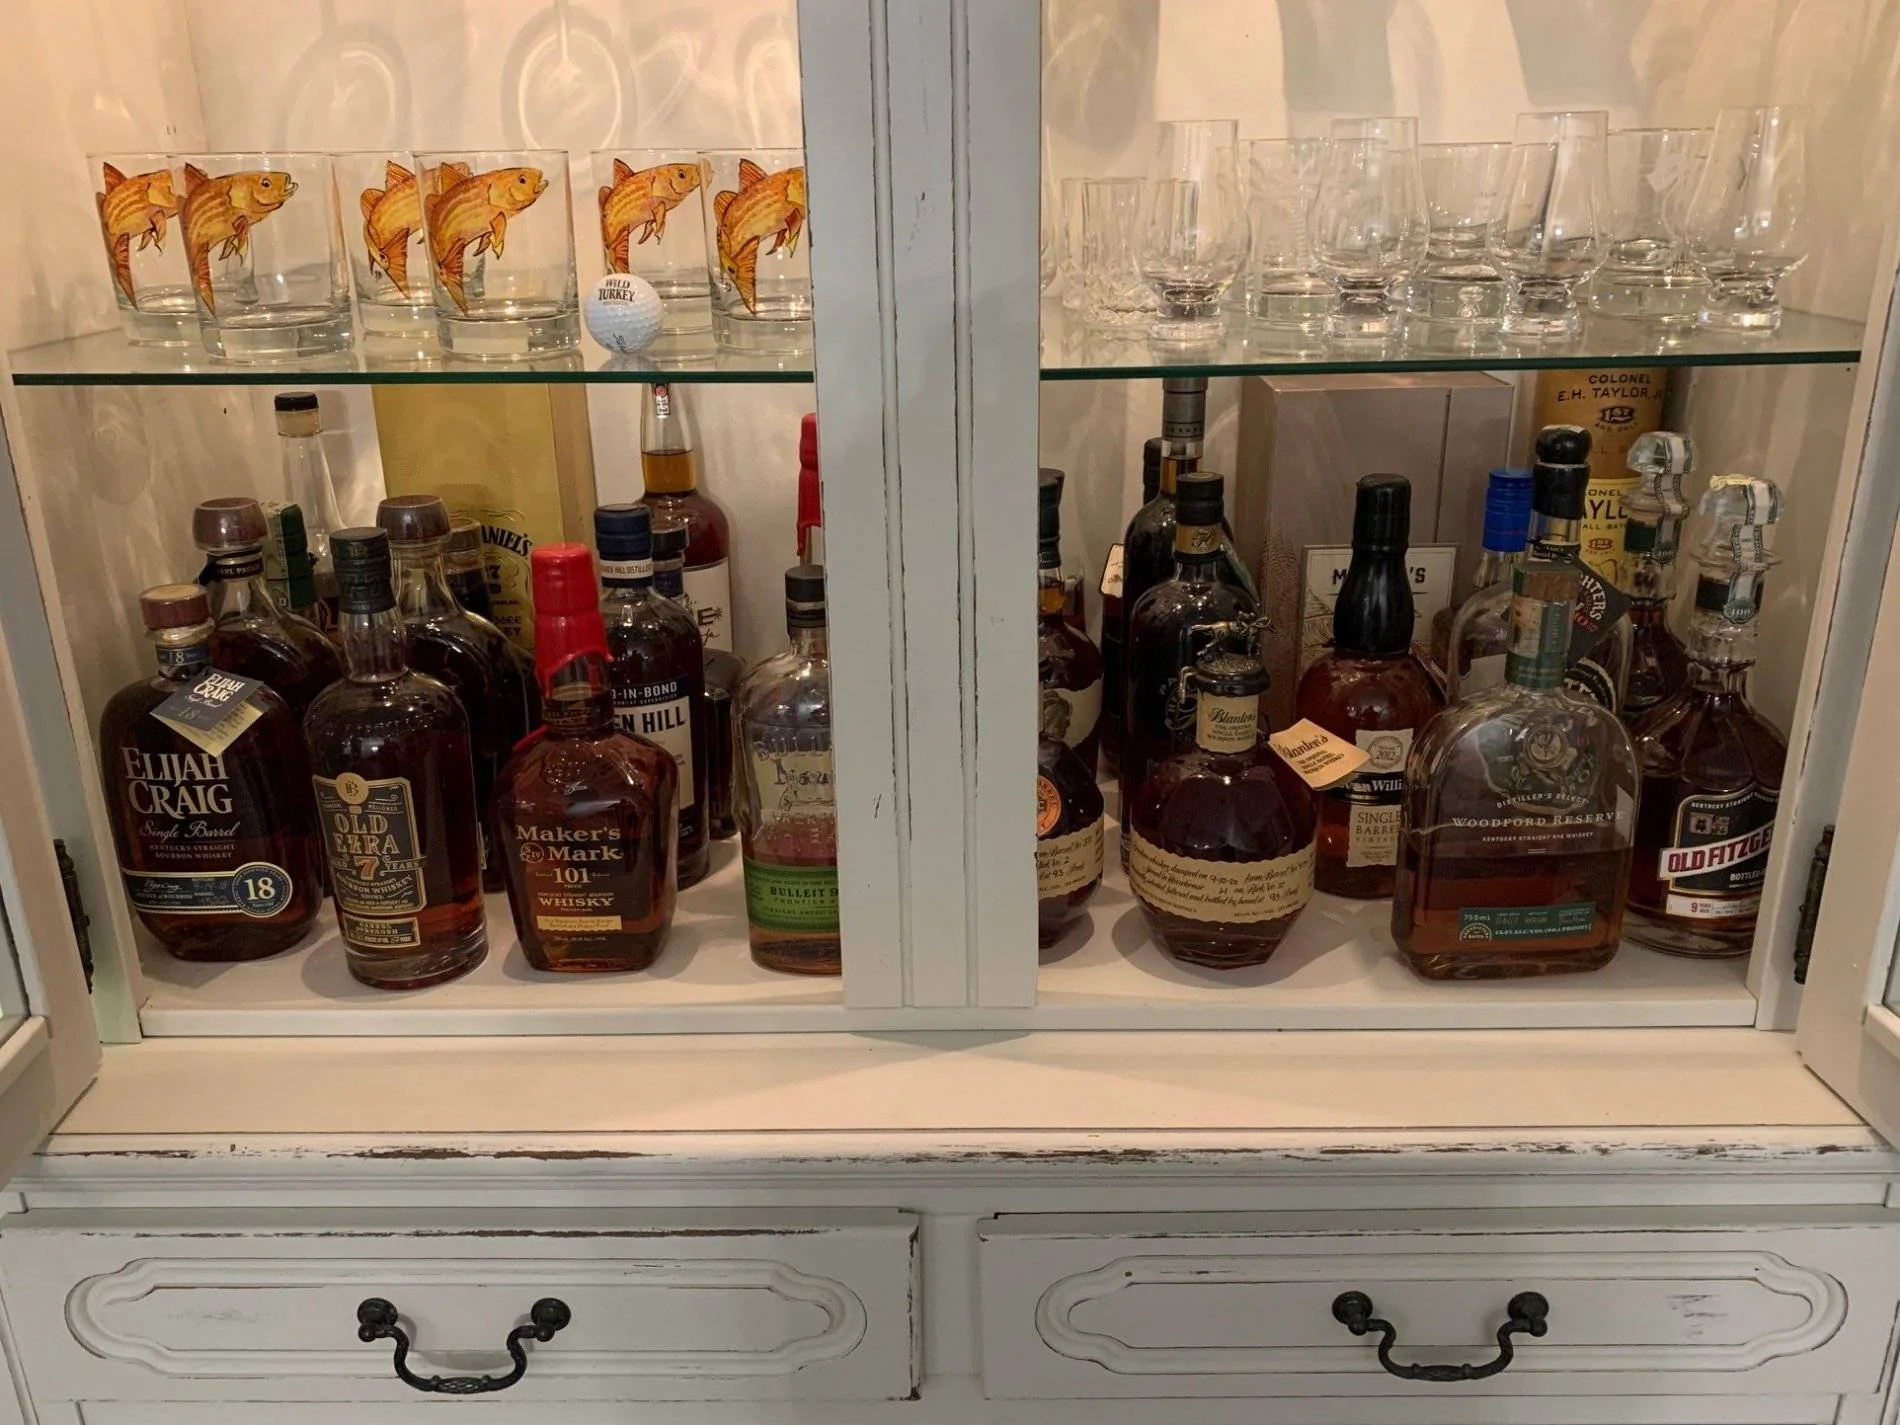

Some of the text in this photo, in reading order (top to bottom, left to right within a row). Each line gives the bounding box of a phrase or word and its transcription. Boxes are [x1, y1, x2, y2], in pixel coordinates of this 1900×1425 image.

[605, 279, 630, 288] WILD
[598, 288, 635, 301] TURKEY
[1588, 374, 1652, 384] COLONEL
[1558, 389, 1586, 401] E.H.
[170, 651, 185, 665] 18
[205, 673, 246, 692] ELIJAH
[193, 682, 234, 702] CRAIG
[178, 706, 201, 720] 18
[642, 706, 685, 733] HILL
[1275, 735, 1329, 759] Blanton's
[120, 746, 231, 788] ELIJAH
[1345, 778, 1403, 792] van Willi
[127, 780, 233, 820] CRAIG
[1496, 793, 1552, 809] DISTILLER'S
[334, 813, 389, 834] OLD
[1357, 811, 1401, 824] SINGLE
[1453, 810, 1624, 827] WOODFORD RESERVE
[139, 820, 241, 843] Single Barrel
[515, 824, 622, 842] Maker's
[332, 833, 401, 856] EZRA
[547, 845, 625, 861] Mark
[1668, 827, 1774, 873] OLD FITZGE
[353, 855, 380, 881] 7
[385, 861, 420, 870] YEARS
[552, 867, 592, 884] 101
[244, 876, 276, 901] 18
[770, 886, 826, 898] BULLEIT
[539, 897, 616, 907] WHISKY
[1691, 902, 1698, 912] 9
